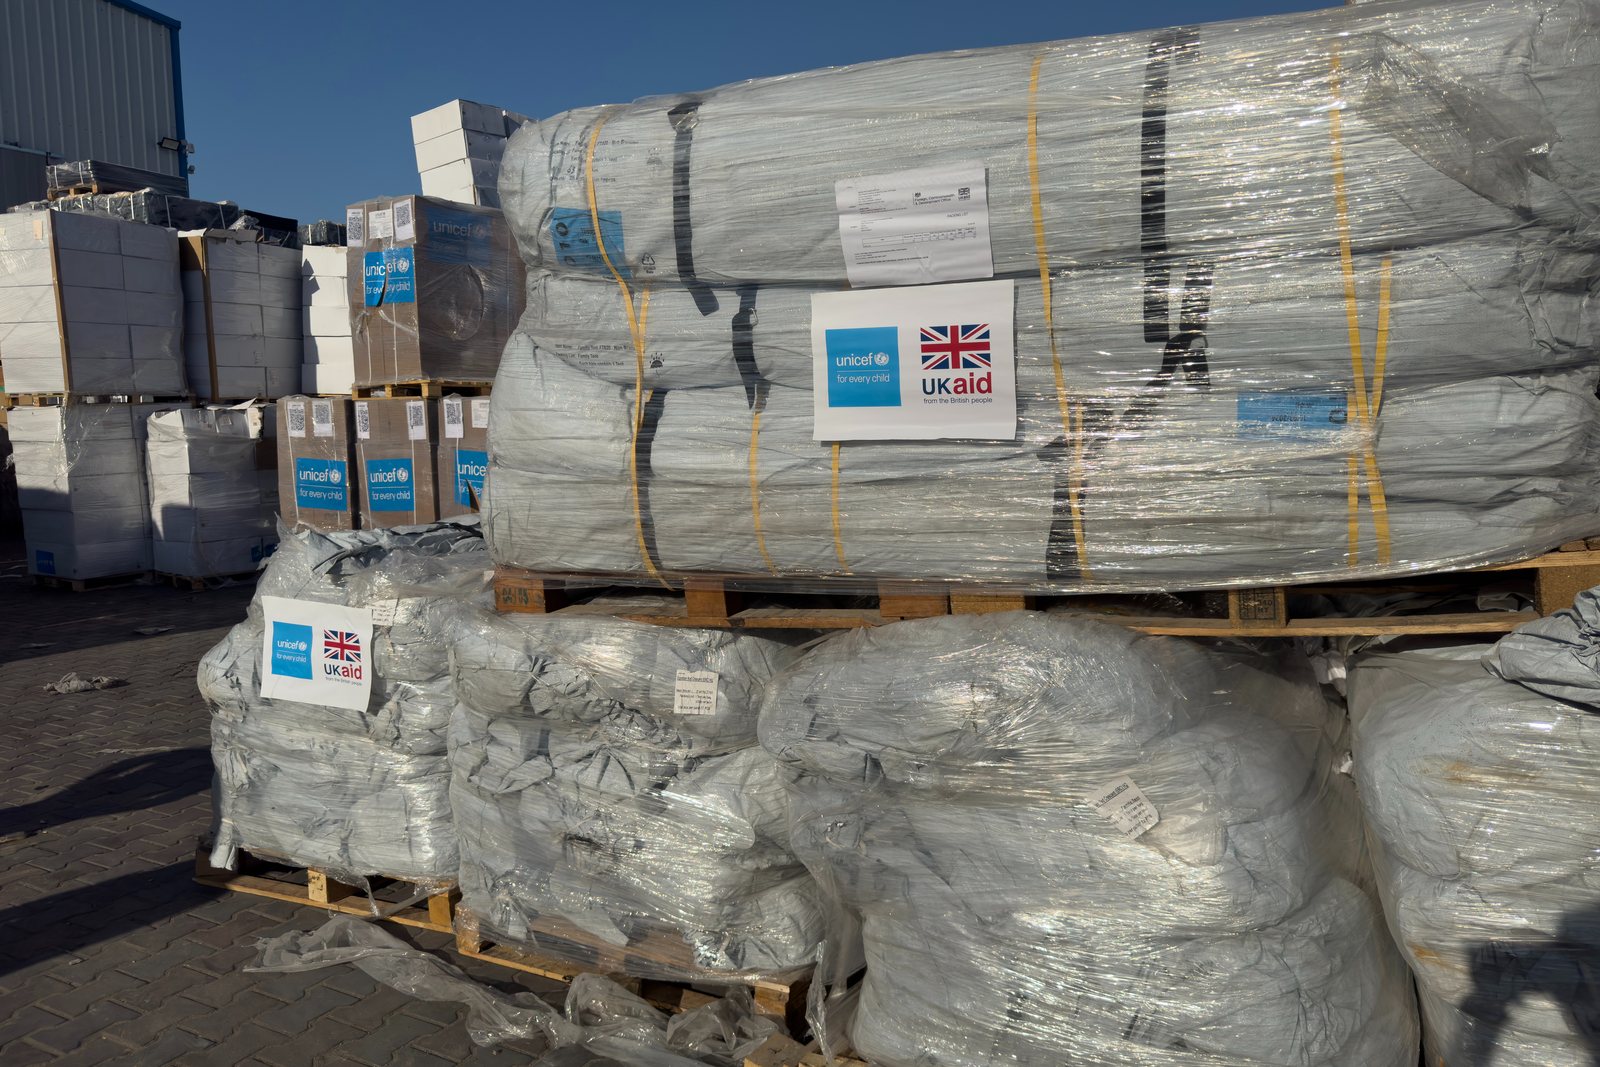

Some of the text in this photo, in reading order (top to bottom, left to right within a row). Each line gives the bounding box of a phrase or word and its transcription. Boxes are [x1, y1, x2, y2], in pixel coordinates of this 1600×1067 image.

[433, 220, 472, 237] unicef
[366, 259, 396, 276] unicef
[836, 353, 873, 366] unicef
[837, 373, 890, 384] for every child
[299, 468, 328, 482] unicef
[370, 468, 396, 482] unicef
[458, 461, 488, 476] unice
[308, 490, 327, 500] every
[327, 491, 343, 500] child
[379, 493, 396, 501] every
[396, 490, 410, 500] child
[277, 640, 299, 650] unicef
